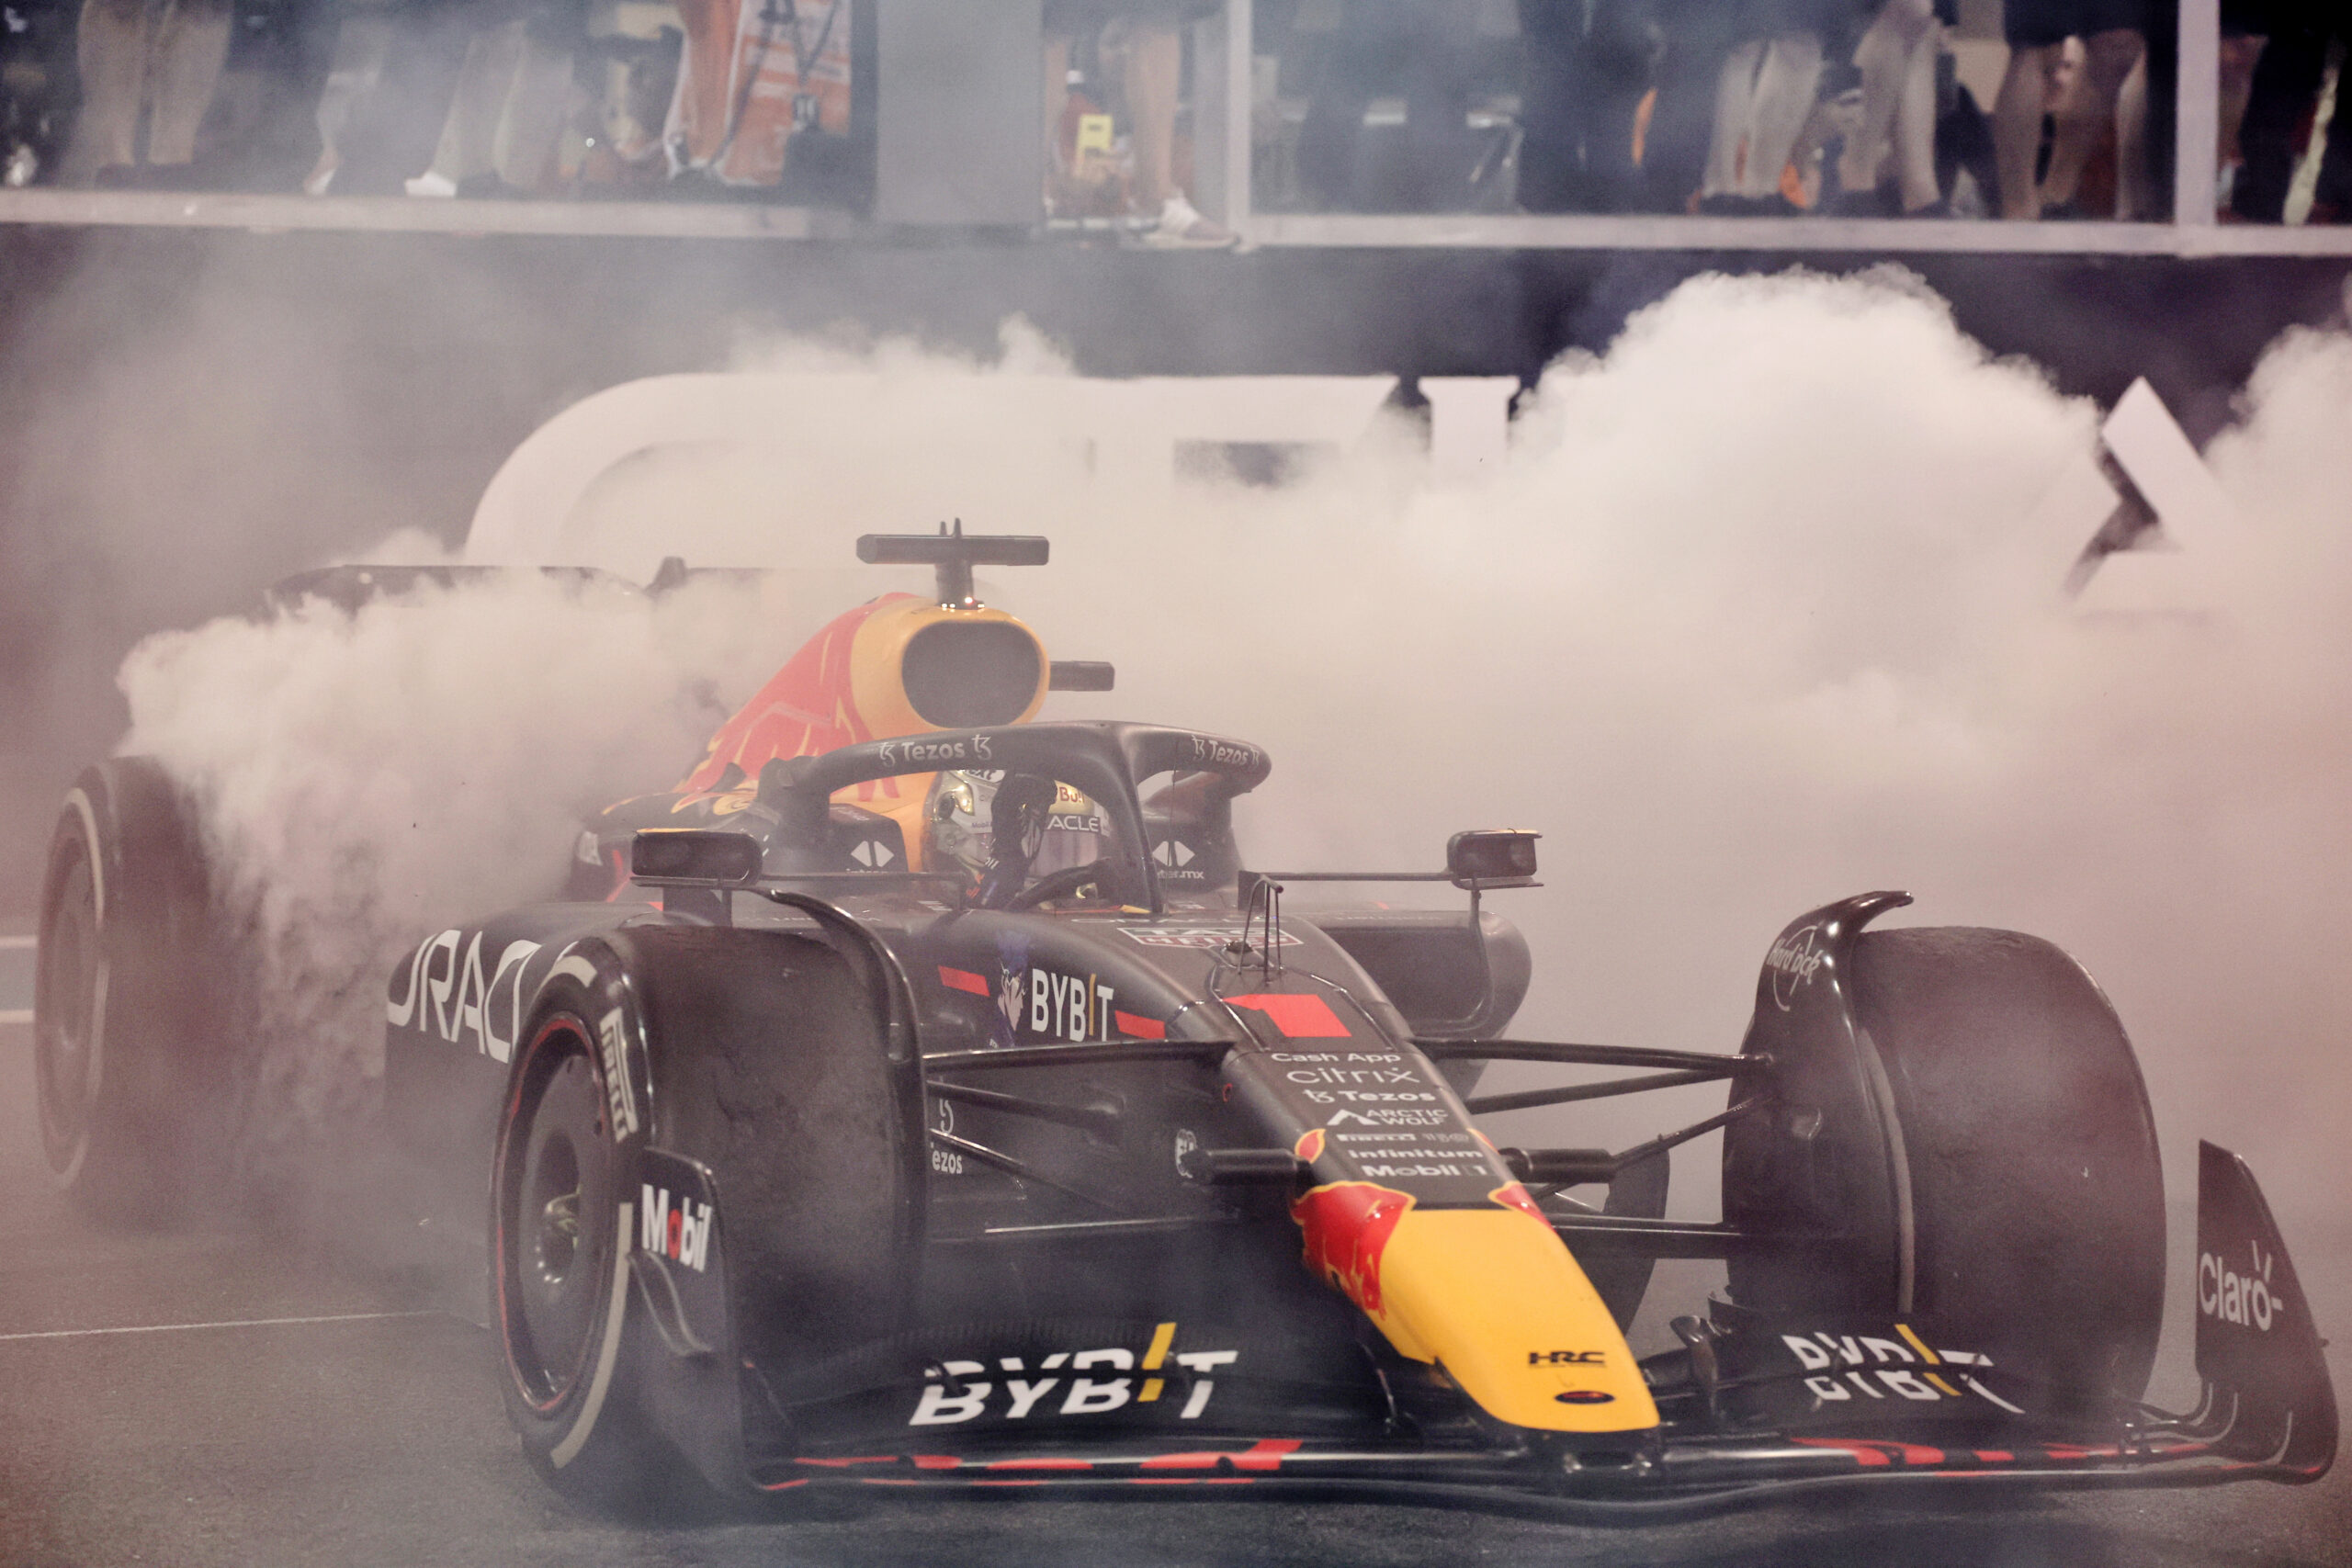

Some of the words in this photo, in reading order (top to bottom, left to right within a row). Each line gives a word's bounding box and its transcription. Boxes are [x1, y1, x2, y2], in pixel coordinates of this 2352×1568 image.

[901, 741, 966, 761] Tezos
[1208, 739, 1249, 765] Tezos
[1047, 816, 1099, 831] ACLE
[1032, 968, 1114, 1042] BYBIT
[1271, 1053, 1338, 1064] Cash
[1347, 1053, 1401, 1065] App
[599, 1006, 639, 1144] PIRELLI
[1339, 1090, 1437, 1101] Tezos
[1366, 1109, 1449, 1118] ARCTIC
[1381, 1116, 1447, 1125] WOLF
[930, 1142, 963, 1175] ezos
[1362, 1165, 1462, 1177] Mobil
[641, 1183, 713, 1273] Mobil
[2199, 1251, 2273, 1332] Claro
[1529, 1350, 1606, 1364] HRC
[909, 1322, 1239, 1426] BYBIT
